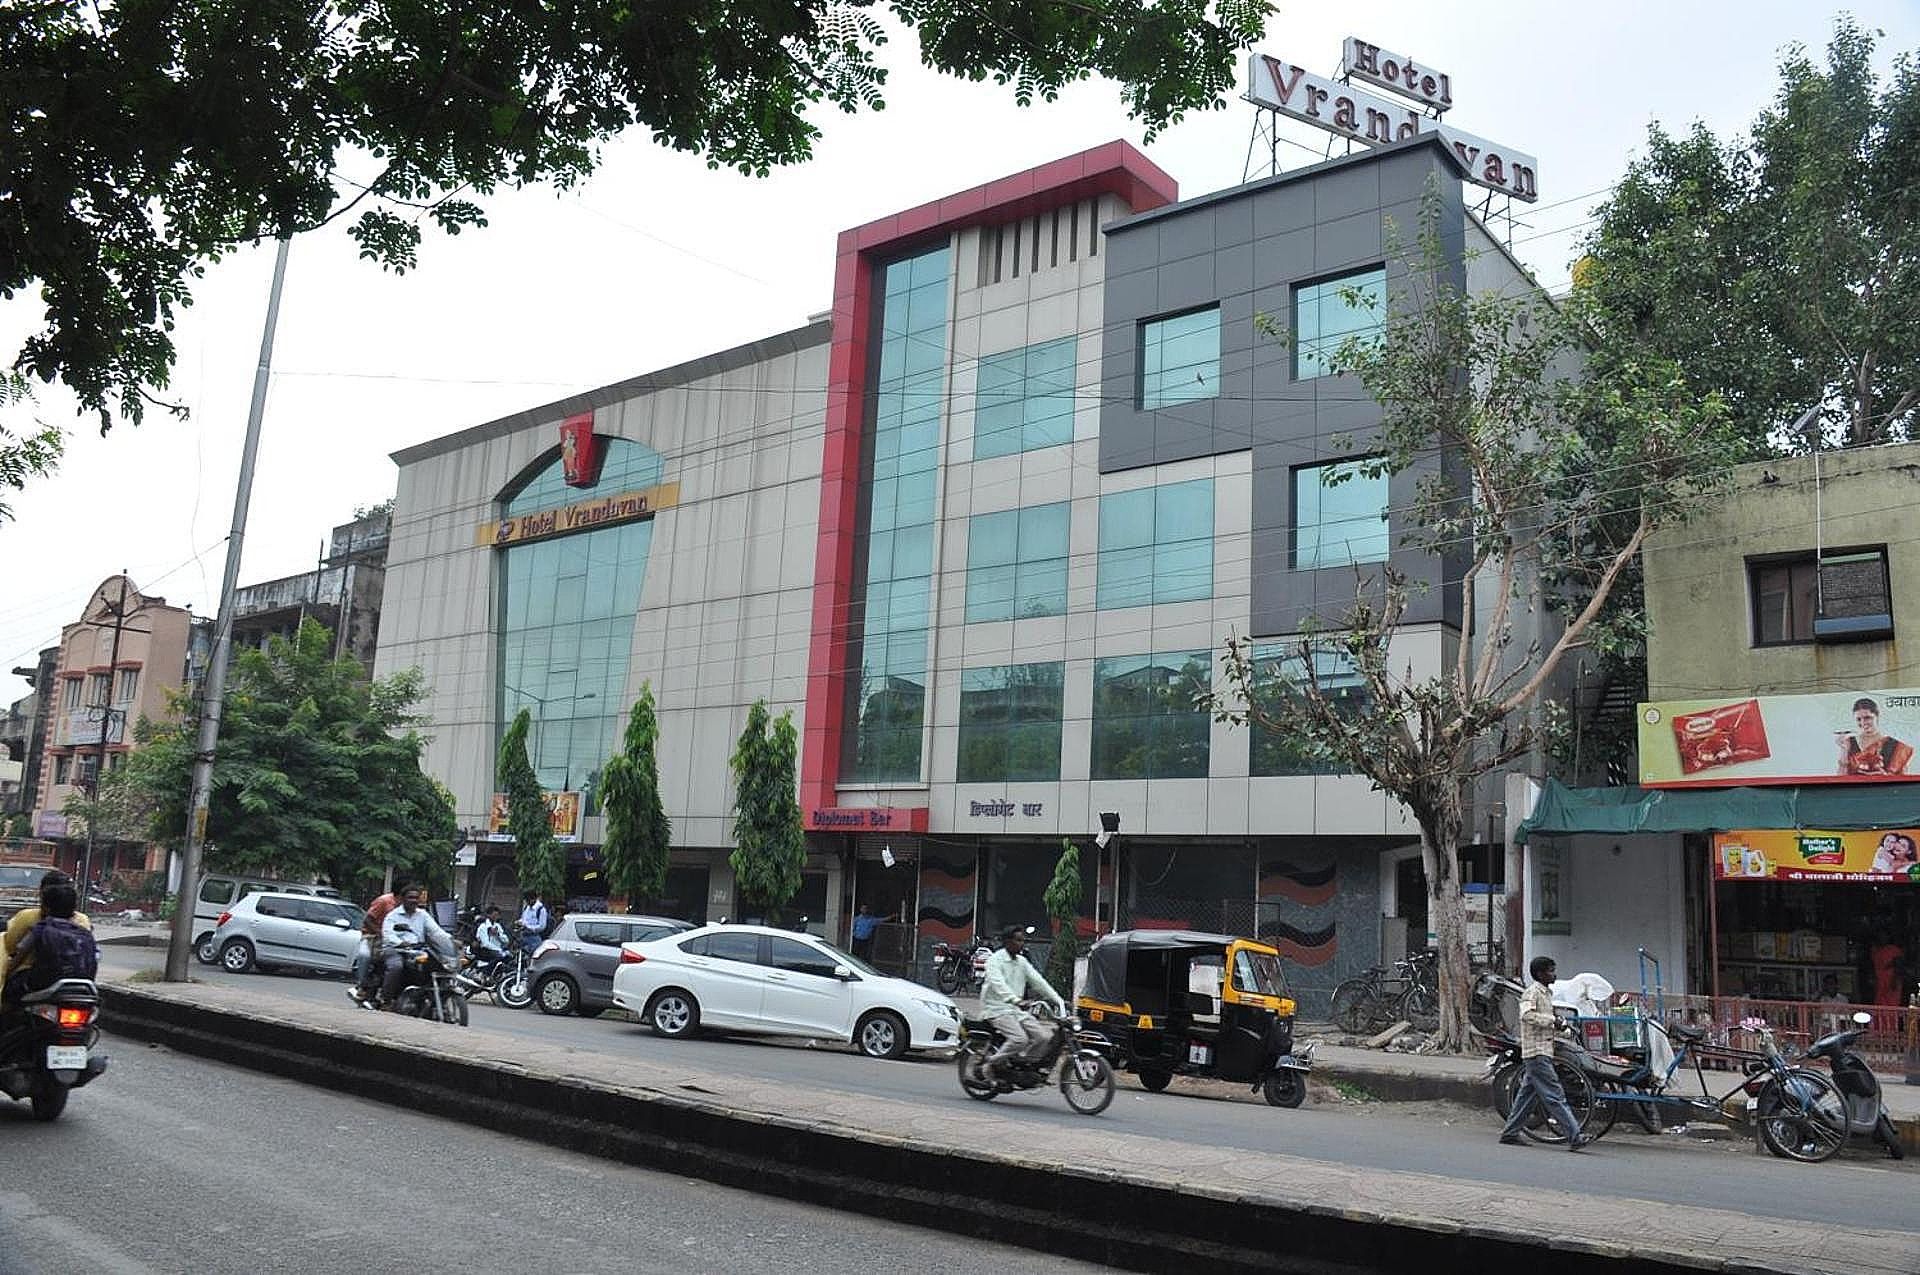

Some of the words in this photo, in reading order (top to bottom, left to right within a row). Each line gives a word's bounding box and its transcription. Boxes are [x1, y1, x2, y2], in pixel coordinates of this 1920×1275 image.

[1354, 38, 1453, 104] Hotel
[1261, 54, 1538, 198] Vrandvan
[520, 510, 556, 538] Hotel
[870, 810, 891, 826] Bar
